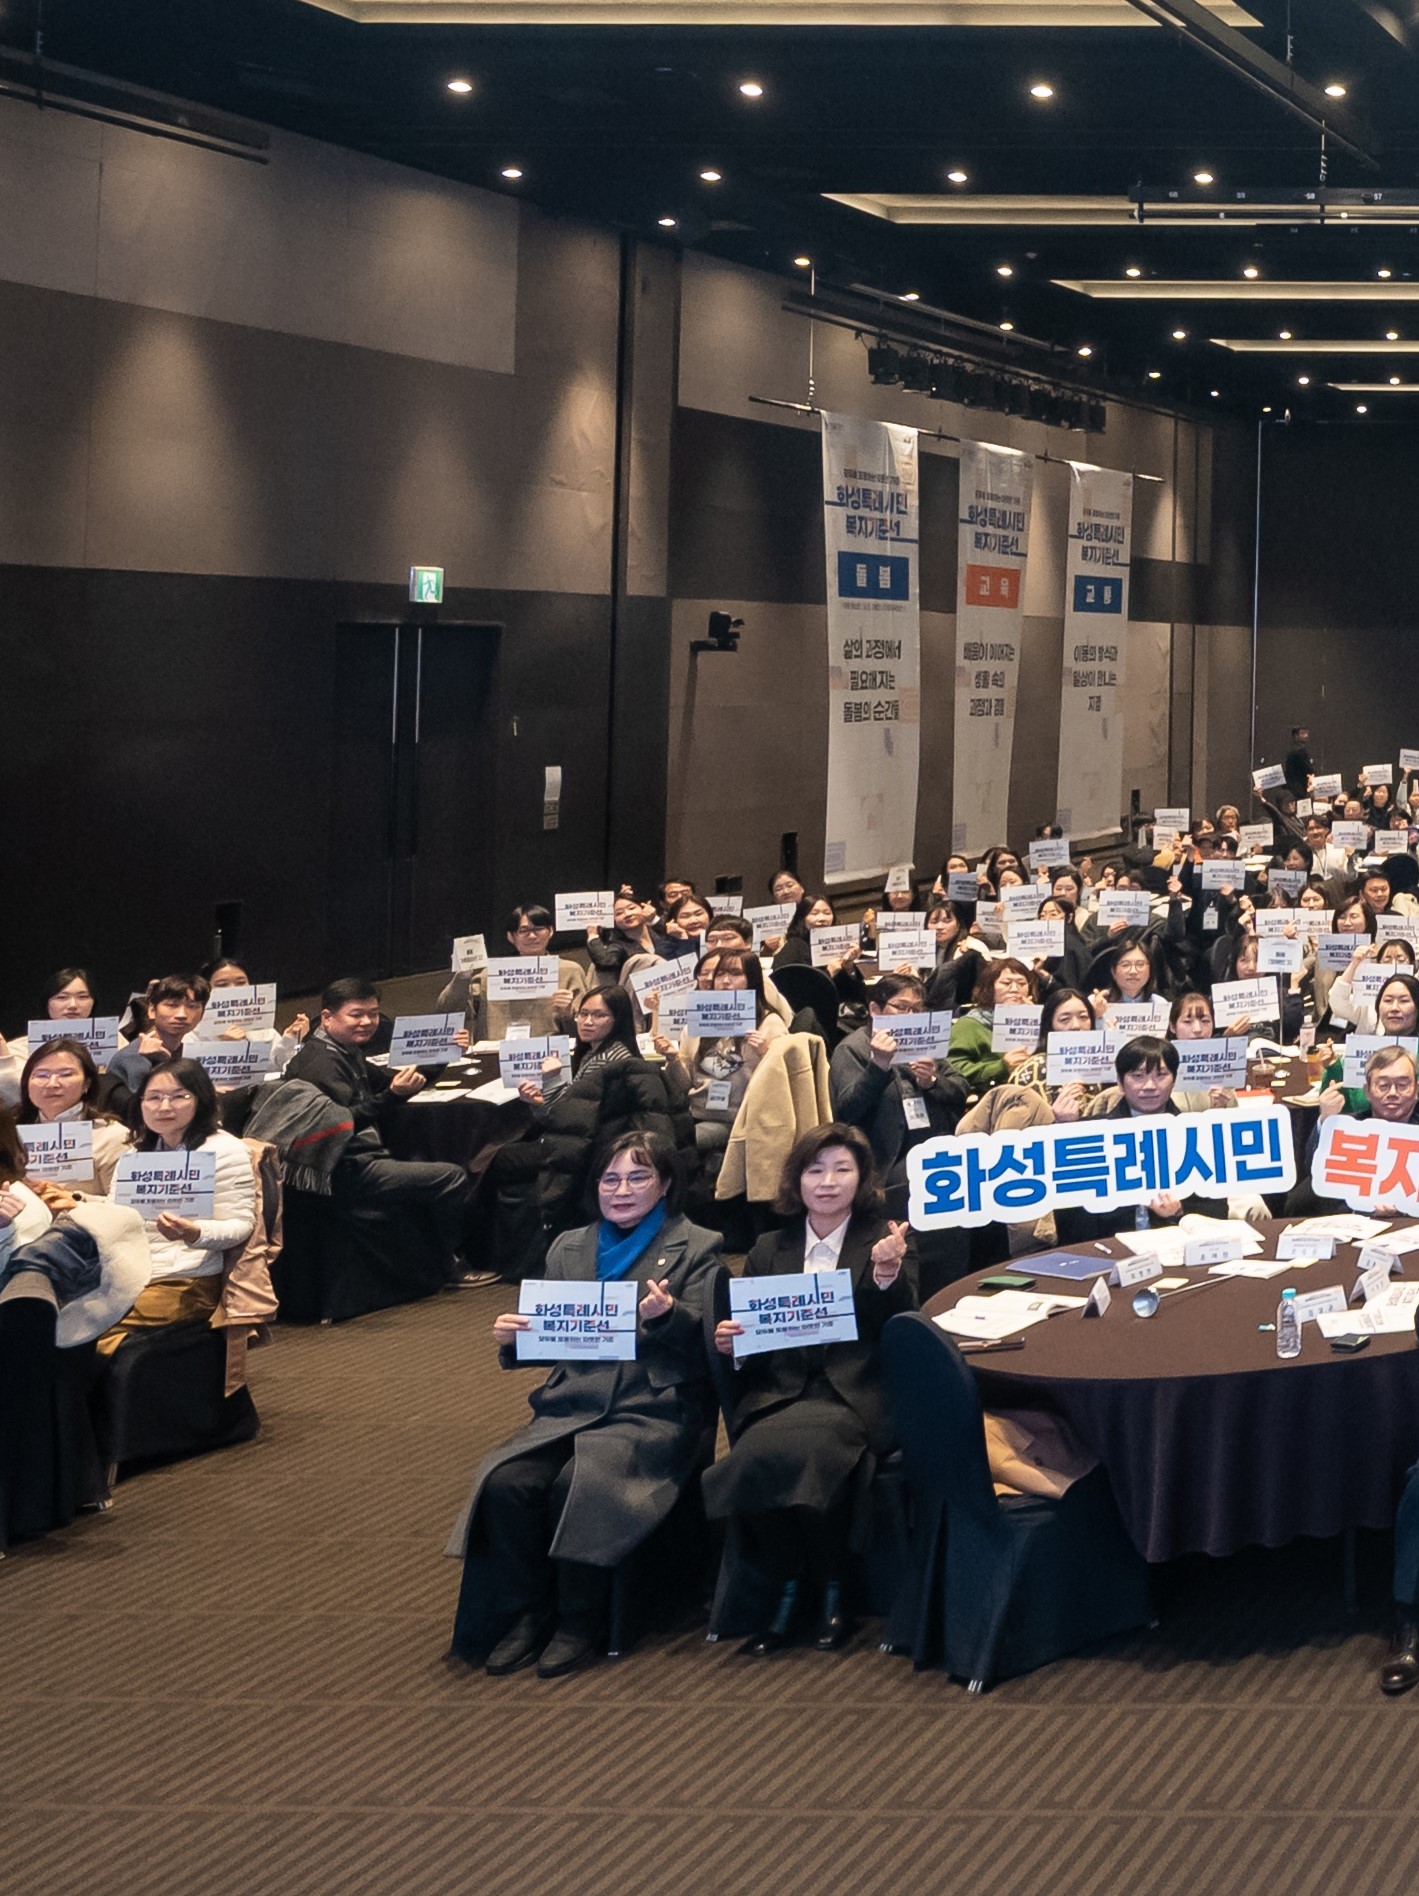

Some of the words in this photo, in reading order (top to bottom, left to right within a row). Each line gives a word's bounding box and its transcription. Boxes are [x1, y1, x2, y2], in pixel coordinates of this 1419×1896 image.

[1181, 1053, 1236, 1063] 화성특례시민
[921, 1118, 1284, 1215] 화성특례시민
[131, 1170, 200, 1181] 화성특례시민
[748, 1291, 834, 1311] 화성특례시민
[535, 1304, 618, 1317] 화성특례시민
[759, 1307, 828, 1324] 복지기준선
[544, 1320, 609, 1332] 복지기준선
